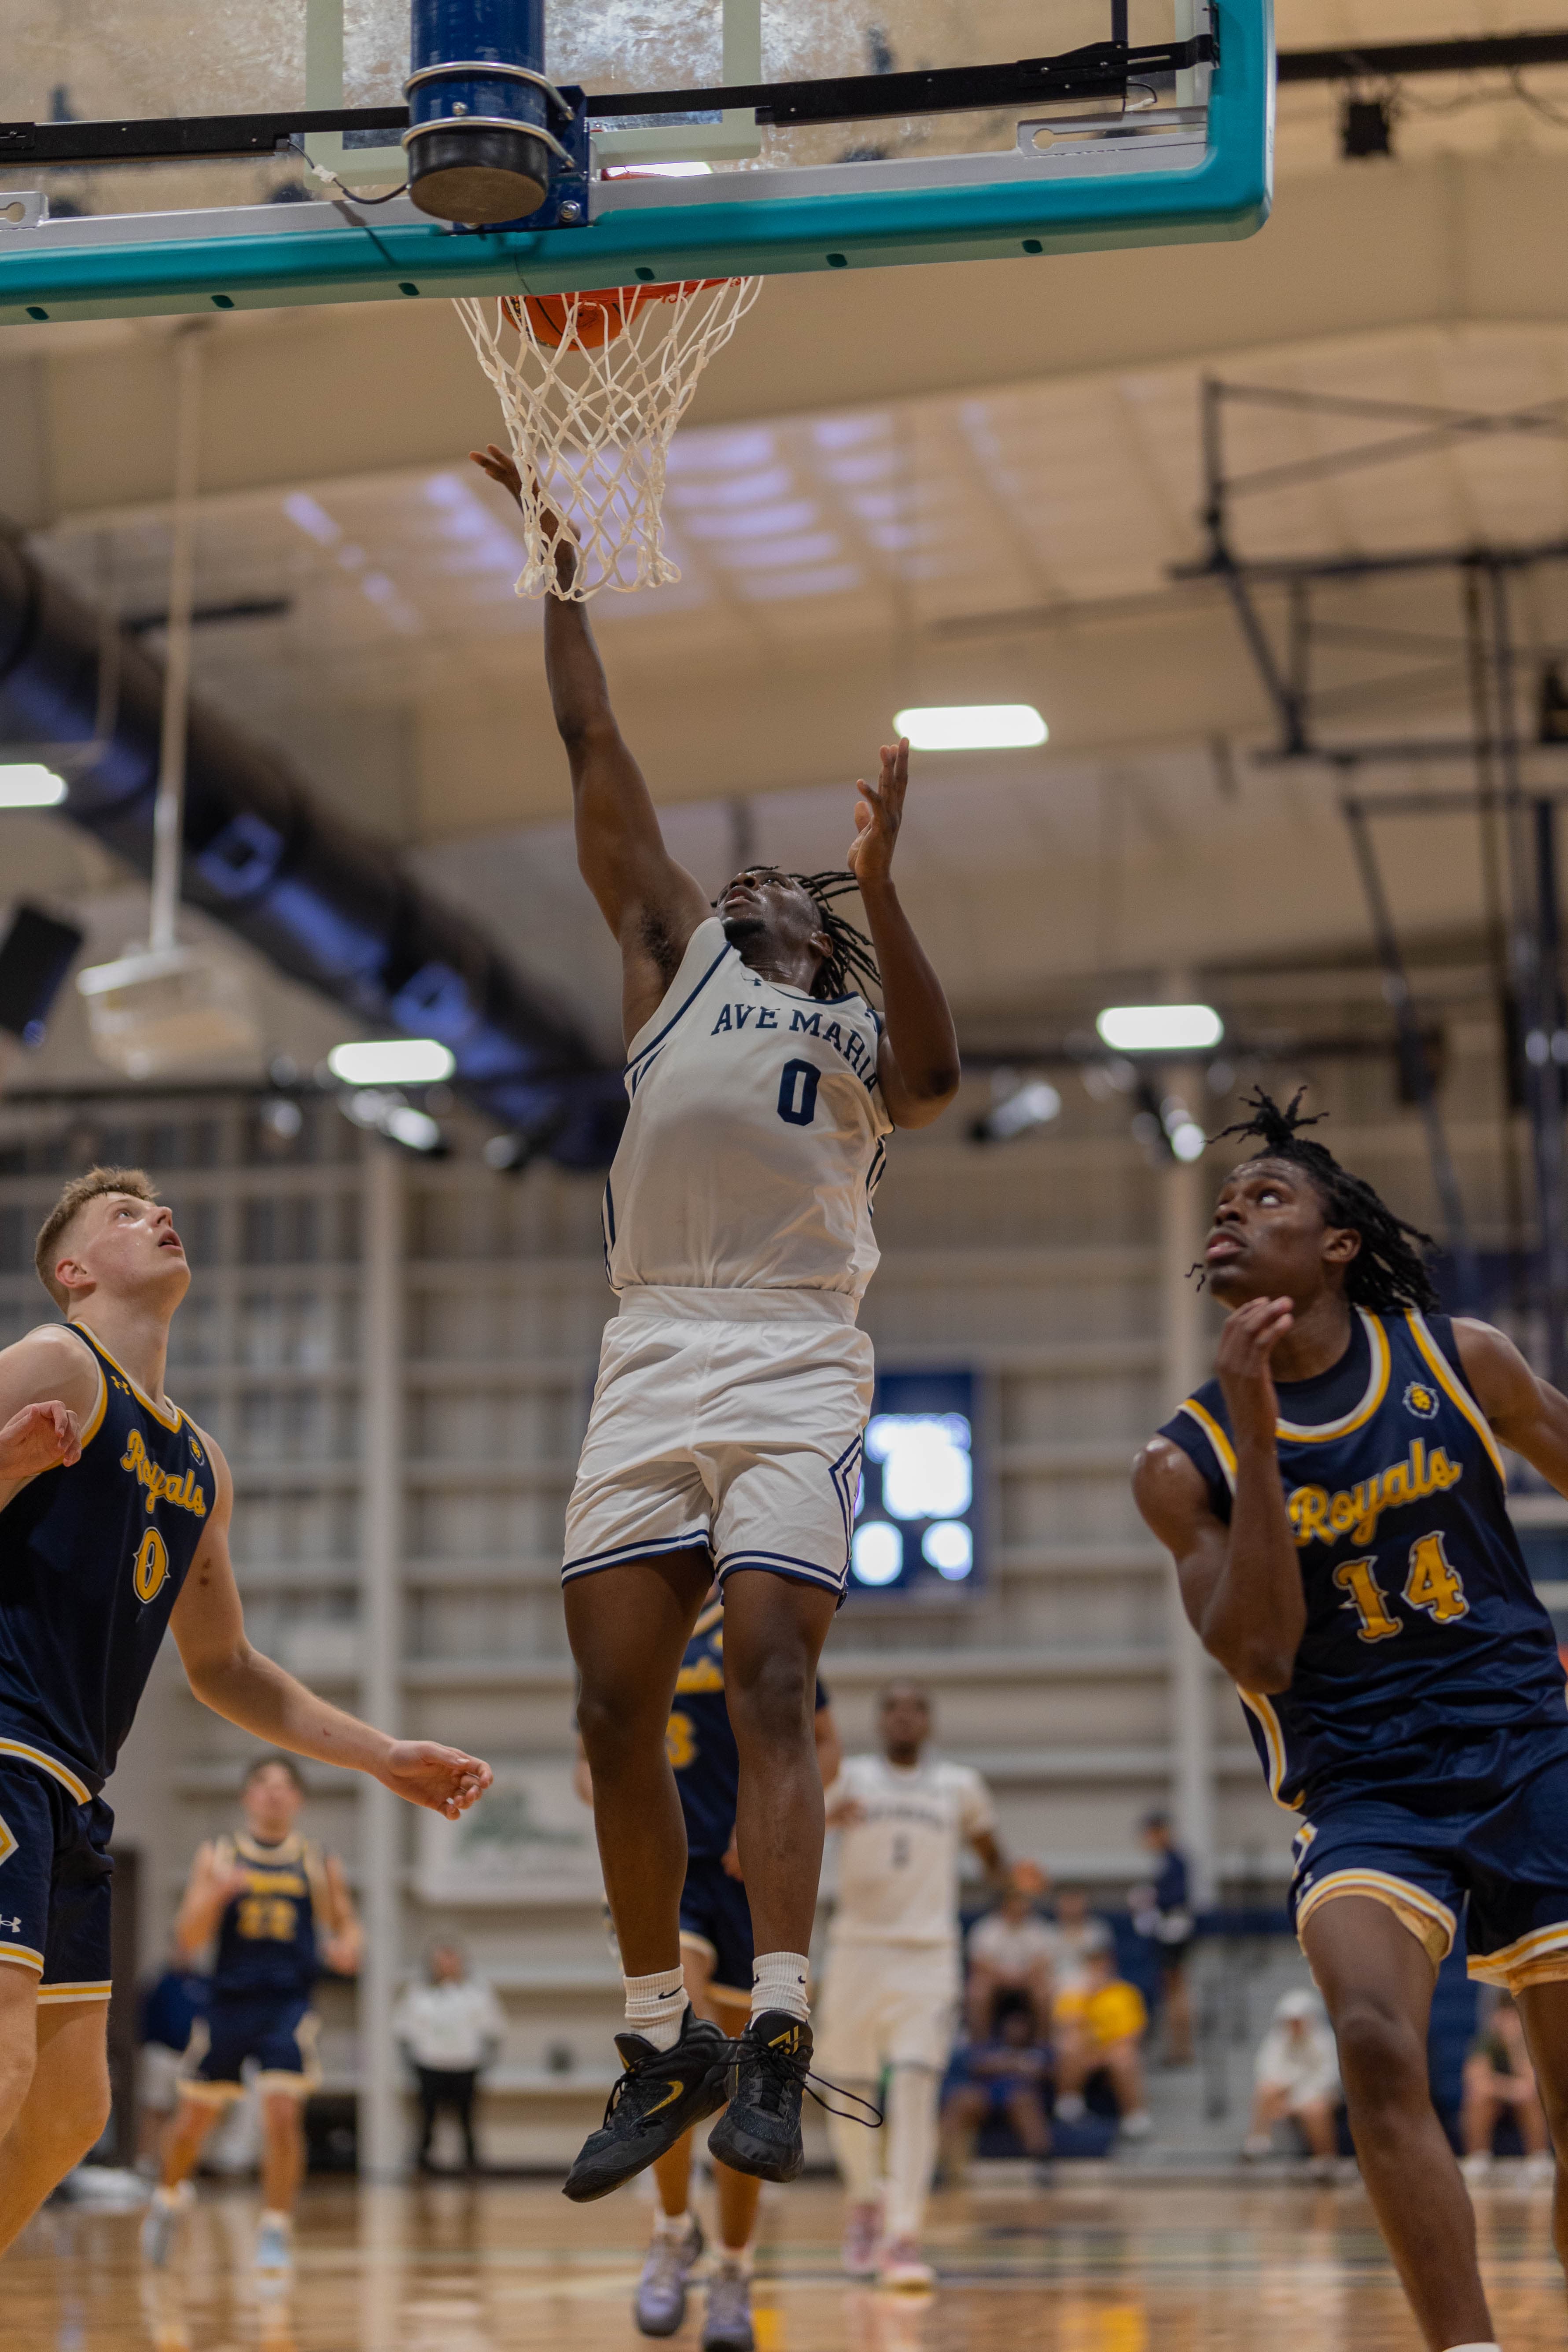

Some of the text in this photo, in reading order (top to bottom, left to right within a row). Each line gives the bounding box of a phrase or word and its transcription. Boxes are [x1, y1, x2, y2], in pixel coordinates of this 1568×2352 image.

[710, 1003, 877, 1094] AVE MARIA
[777, 1058, 821, 1126] 0
[120, 1428, 206, 1517] Royals
[1285, 1437, 1463, 1546] Royals
[133, 1526, 171, 1605] 0
[1332, 1530, 1470, 1644] 14
